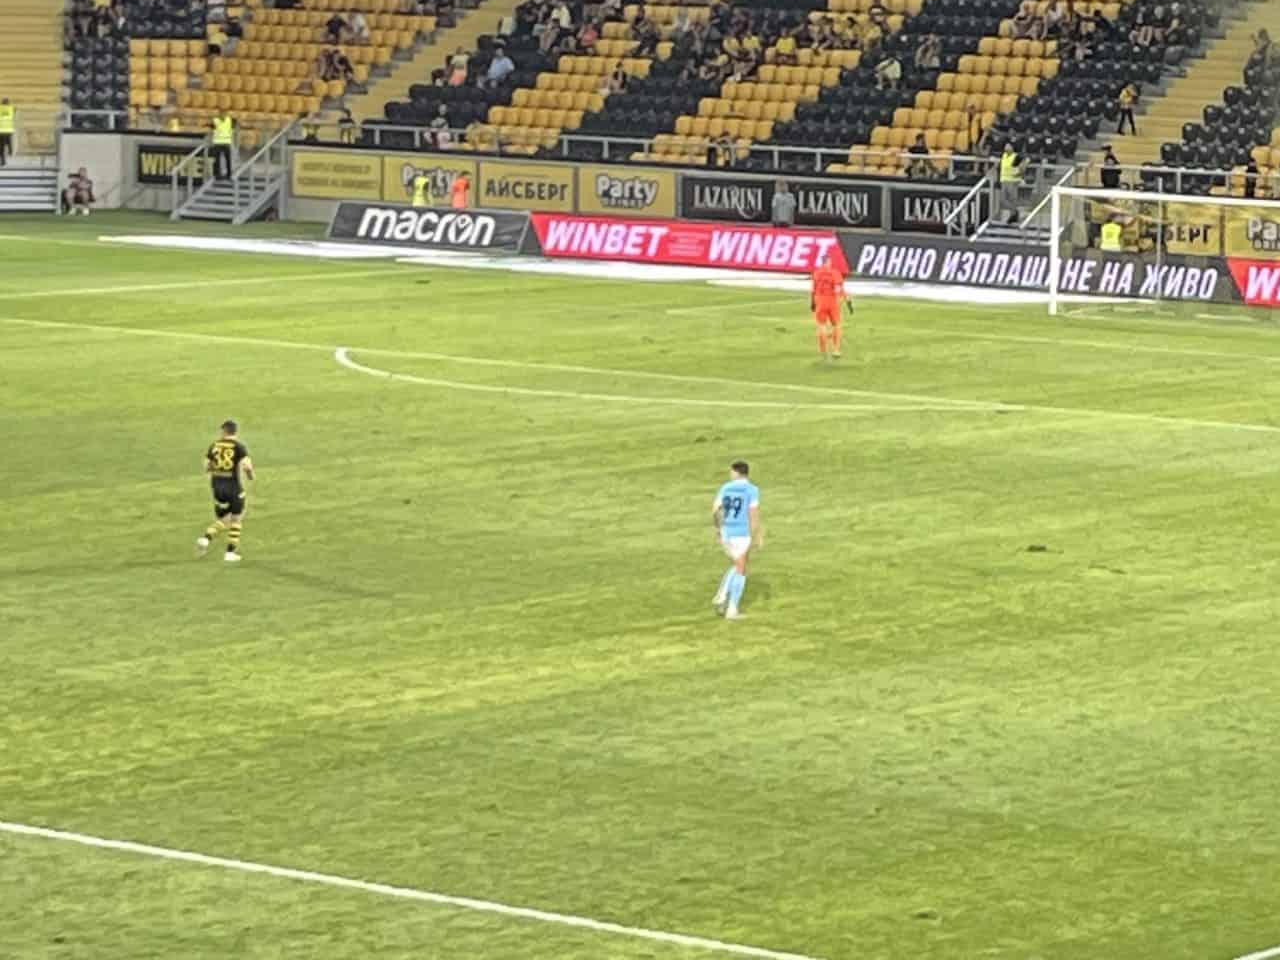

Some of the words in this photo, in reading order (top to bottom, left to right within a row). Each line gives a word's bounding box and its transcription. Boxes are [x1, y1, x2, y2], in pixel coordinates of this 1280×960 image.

[485, 175, 568, 201] АЙСБЕРГ
[597, 174, 657, 206] Party
[355, 208, 496, 246] macron
[543, 220, 670, 257] WINBET
[708, 230, 838, 267] WINBET
[857, 243, 936, 281] РАННО
[1099, 261, 1133, 294] НА
[1139, 264, 1218, 299] ЖИВО
